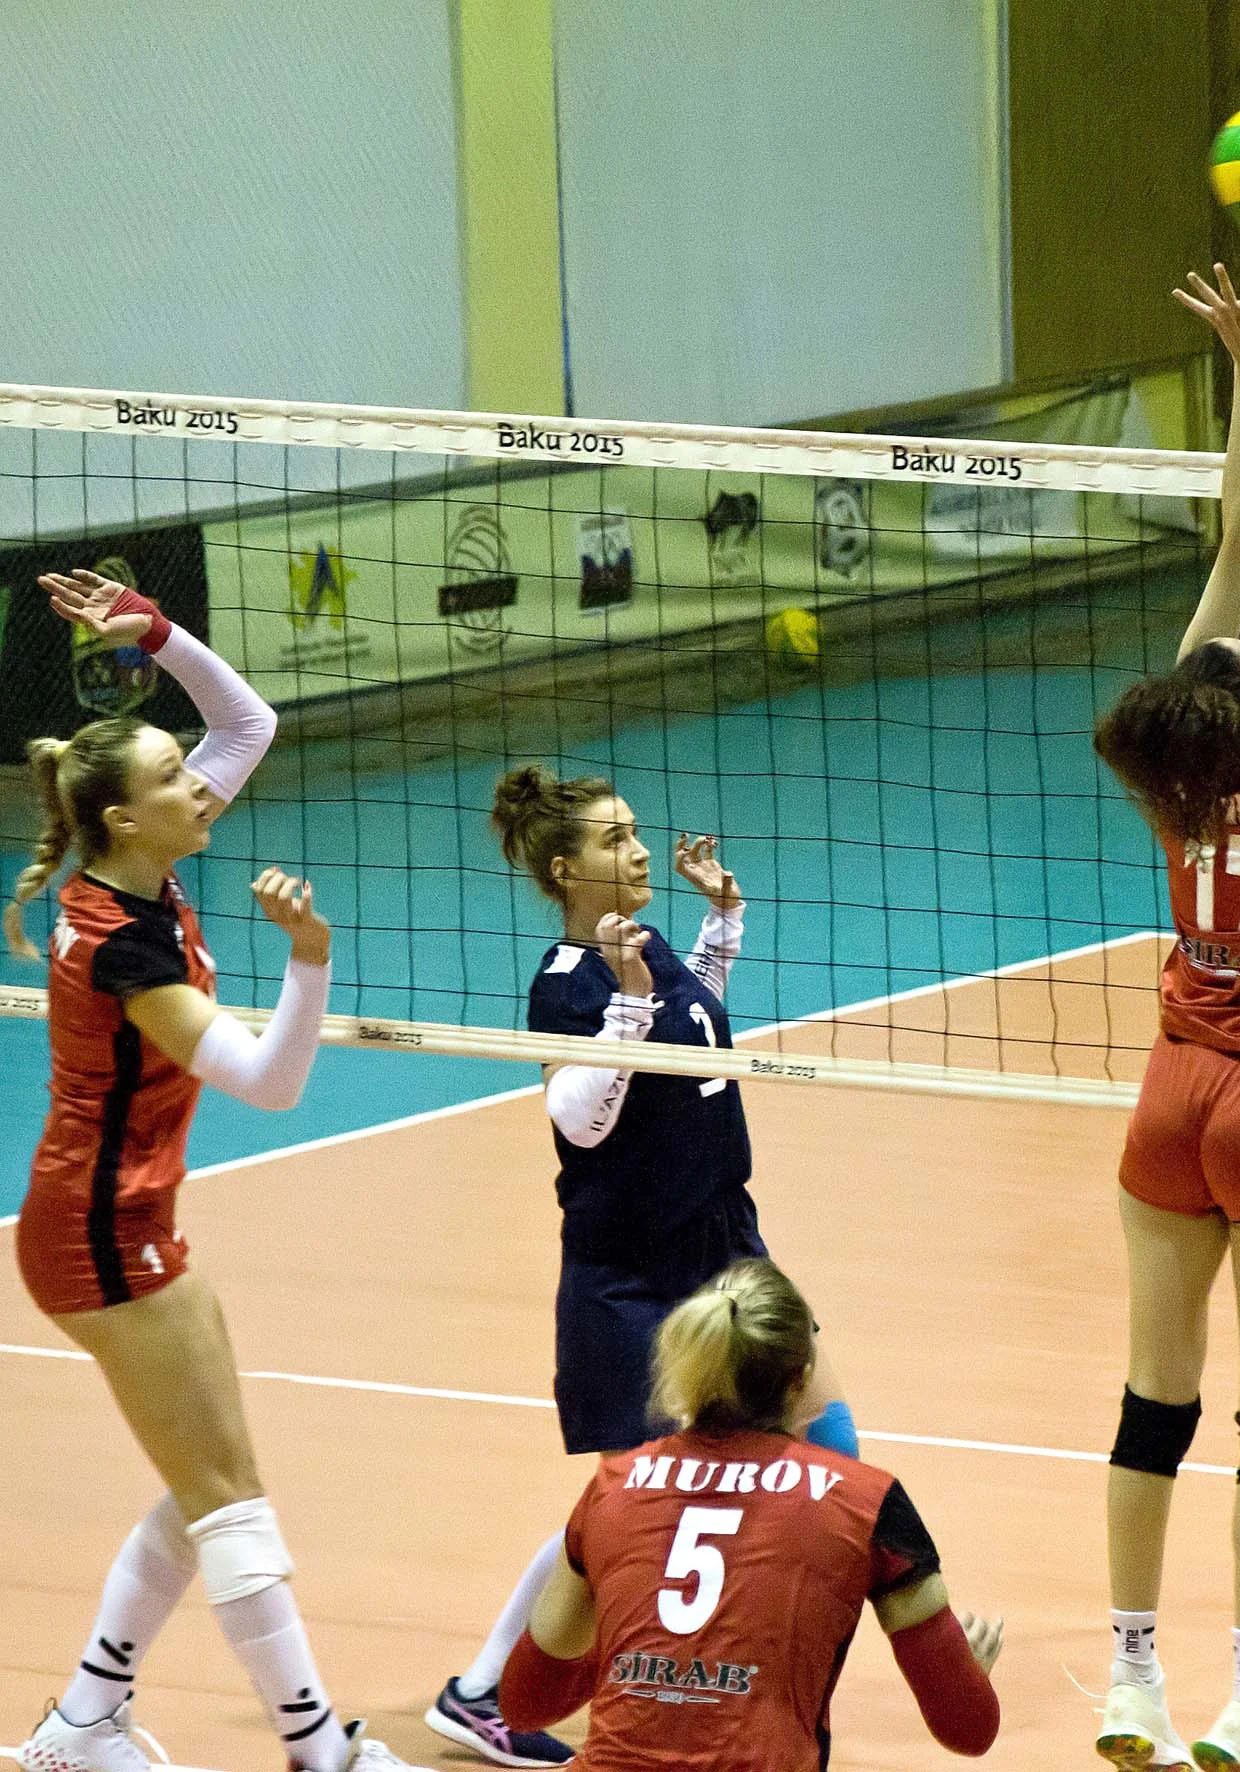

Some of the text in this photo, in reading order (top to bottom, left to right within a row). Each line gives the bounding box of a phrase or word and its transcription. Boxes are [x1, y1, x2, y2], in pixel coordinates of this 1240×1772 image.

[116, 398, 238, 434] Baku 2015
[497, 421, 624, 456] Baku 2015
[890, 445, 1023, 481] Baku 2015
[623, 1455, 844, 1501] MUROV
[657, 1505, 744, 1635] 5
